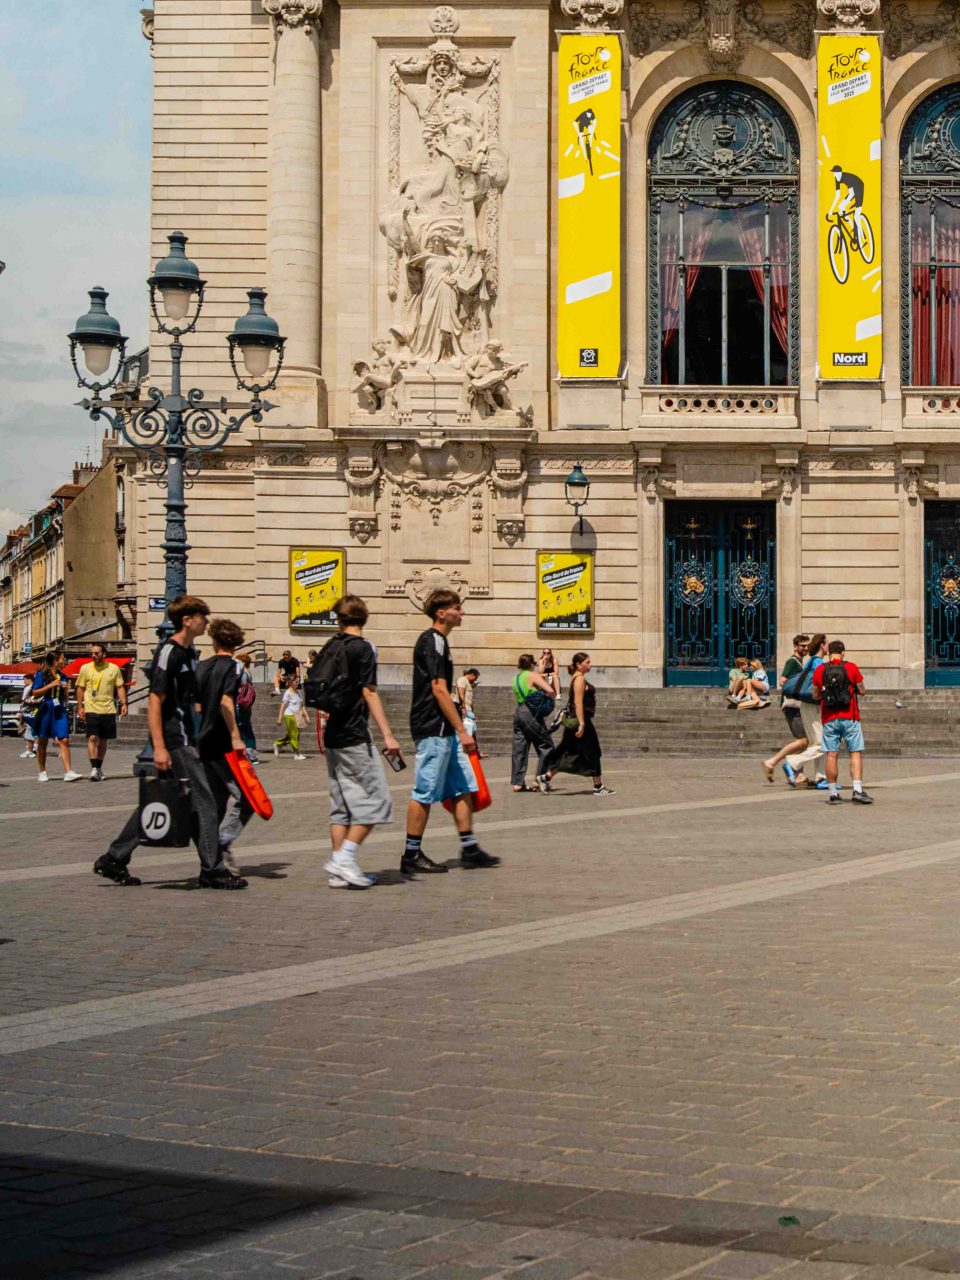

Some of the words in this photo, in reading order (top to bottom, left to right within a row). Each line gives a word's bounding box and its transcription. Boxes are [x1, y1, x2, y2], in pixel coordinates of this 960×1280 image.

[831, 81, 848, 91] GRAND
[834, 352, 866, 363] Nord
[145, 811, 167, 830] JD
